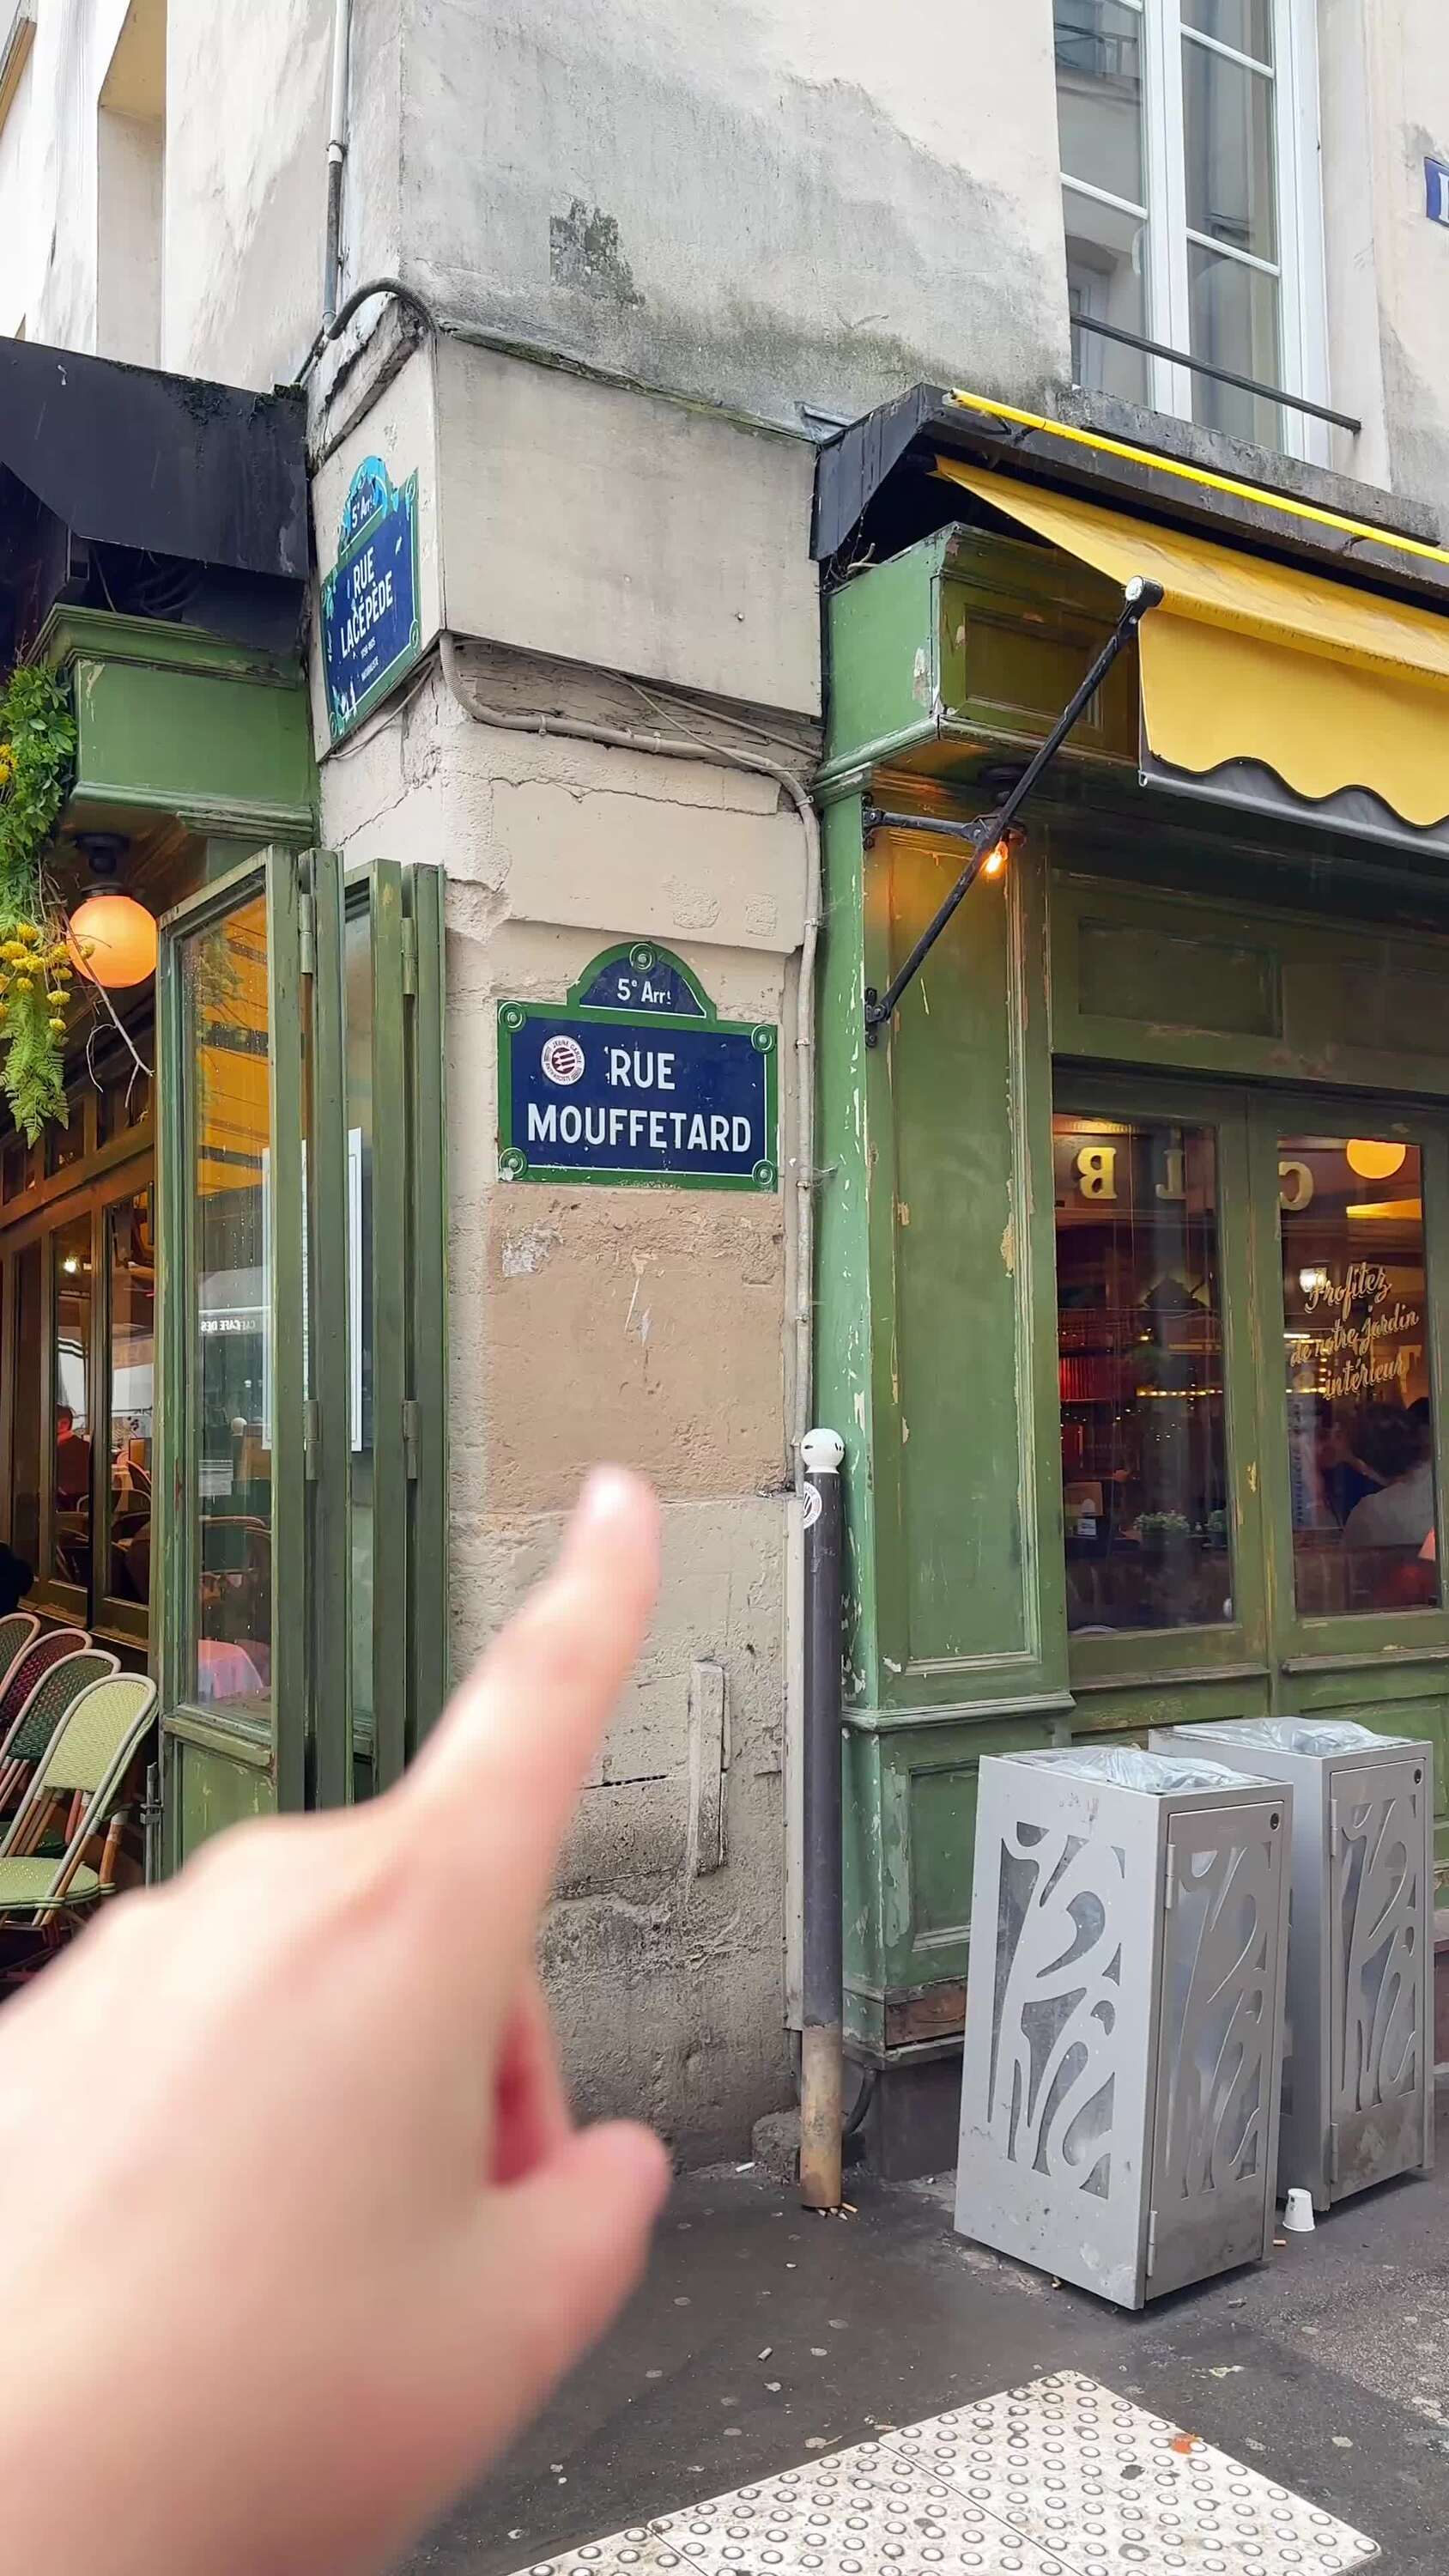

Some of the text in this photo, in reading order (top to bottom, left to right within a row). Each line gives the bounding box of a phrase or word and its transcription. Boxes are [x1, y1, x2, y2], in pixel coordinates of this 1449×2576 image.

[354, 547, 374, 598] RUE
[341, 570, 393, 659] LACÉPÈDE
[610, 1048, 676, 1090] RUE
[528, 1103, 751, 1152] MOUFFETARD
[1304, 1261, 1392, 1321] Profitez
[1290, 1302, 1420, 1367] de notre jardin
[1323, 1352, 1408, 1400] intérieur
